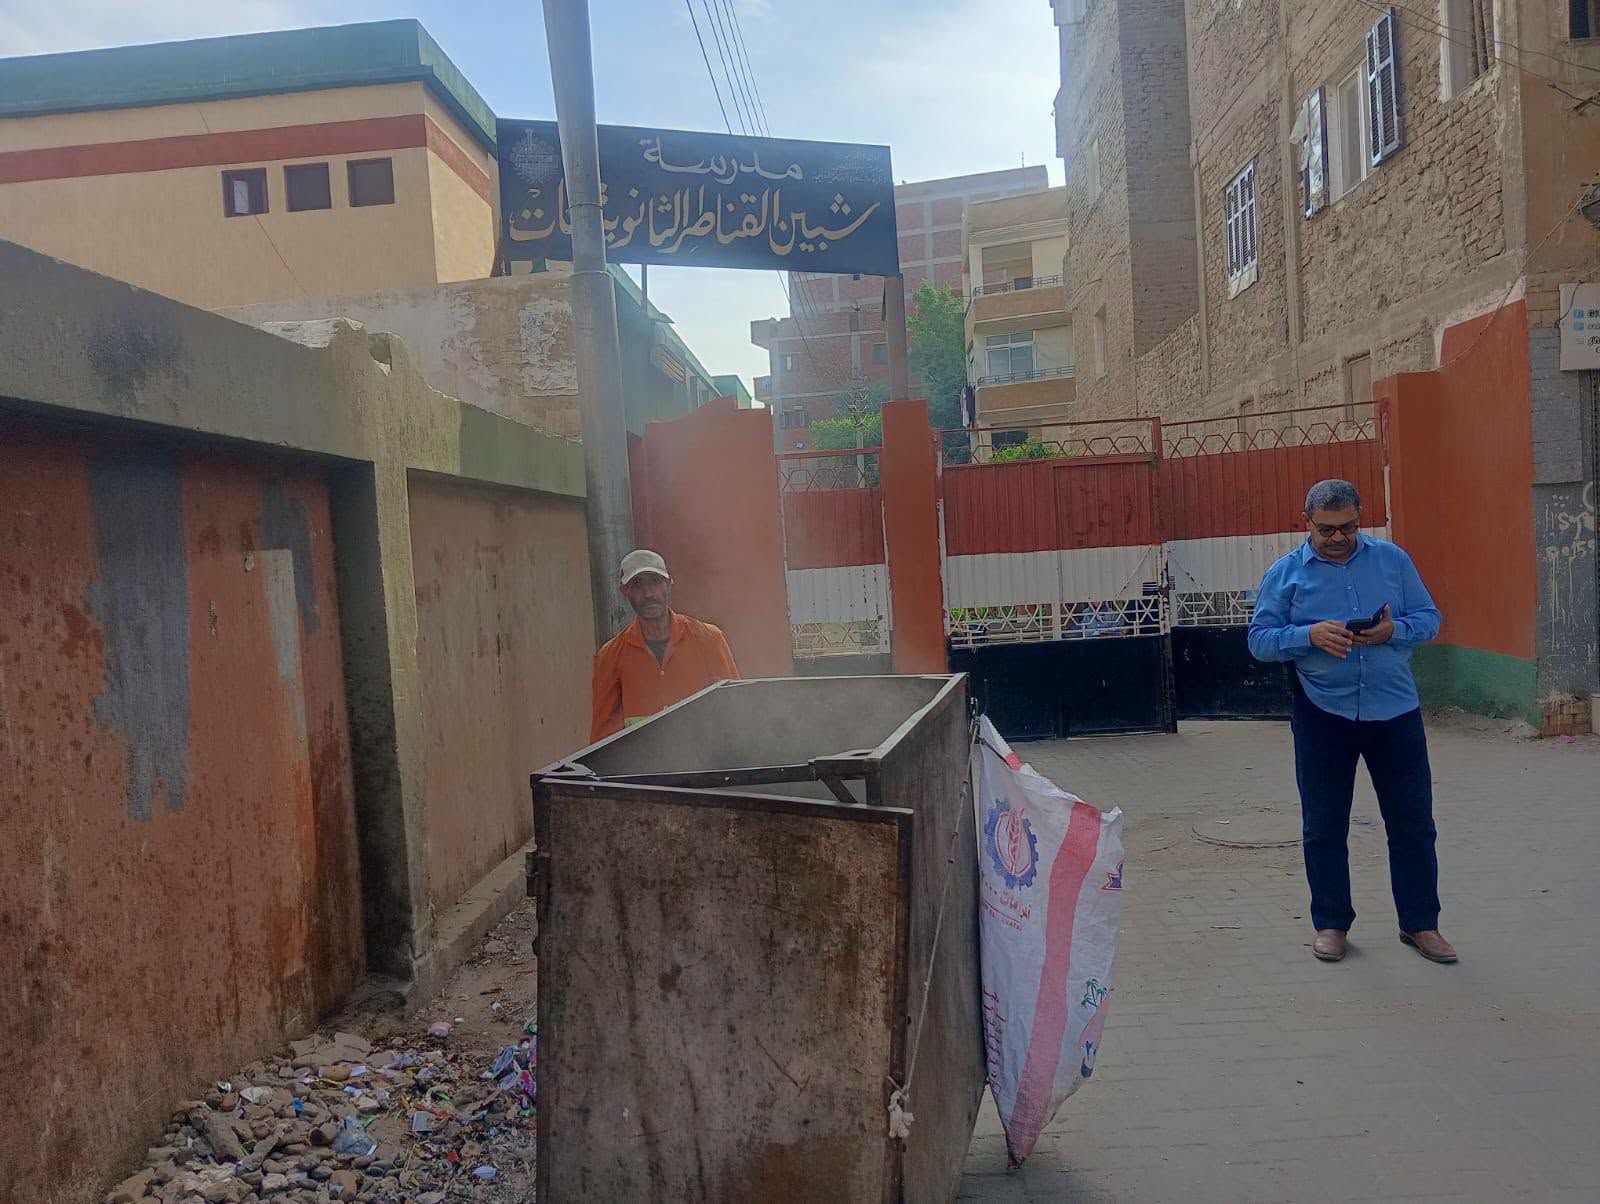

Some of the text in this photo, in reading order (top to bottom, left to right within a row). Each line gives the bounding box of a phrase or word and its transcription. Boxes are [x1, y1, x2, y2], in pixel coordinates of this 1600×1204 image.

[638, 136, 803, 185] مدرسة
[601, 182, 690, 249] الثانوي
[769, 192, 881, 256] شبين
